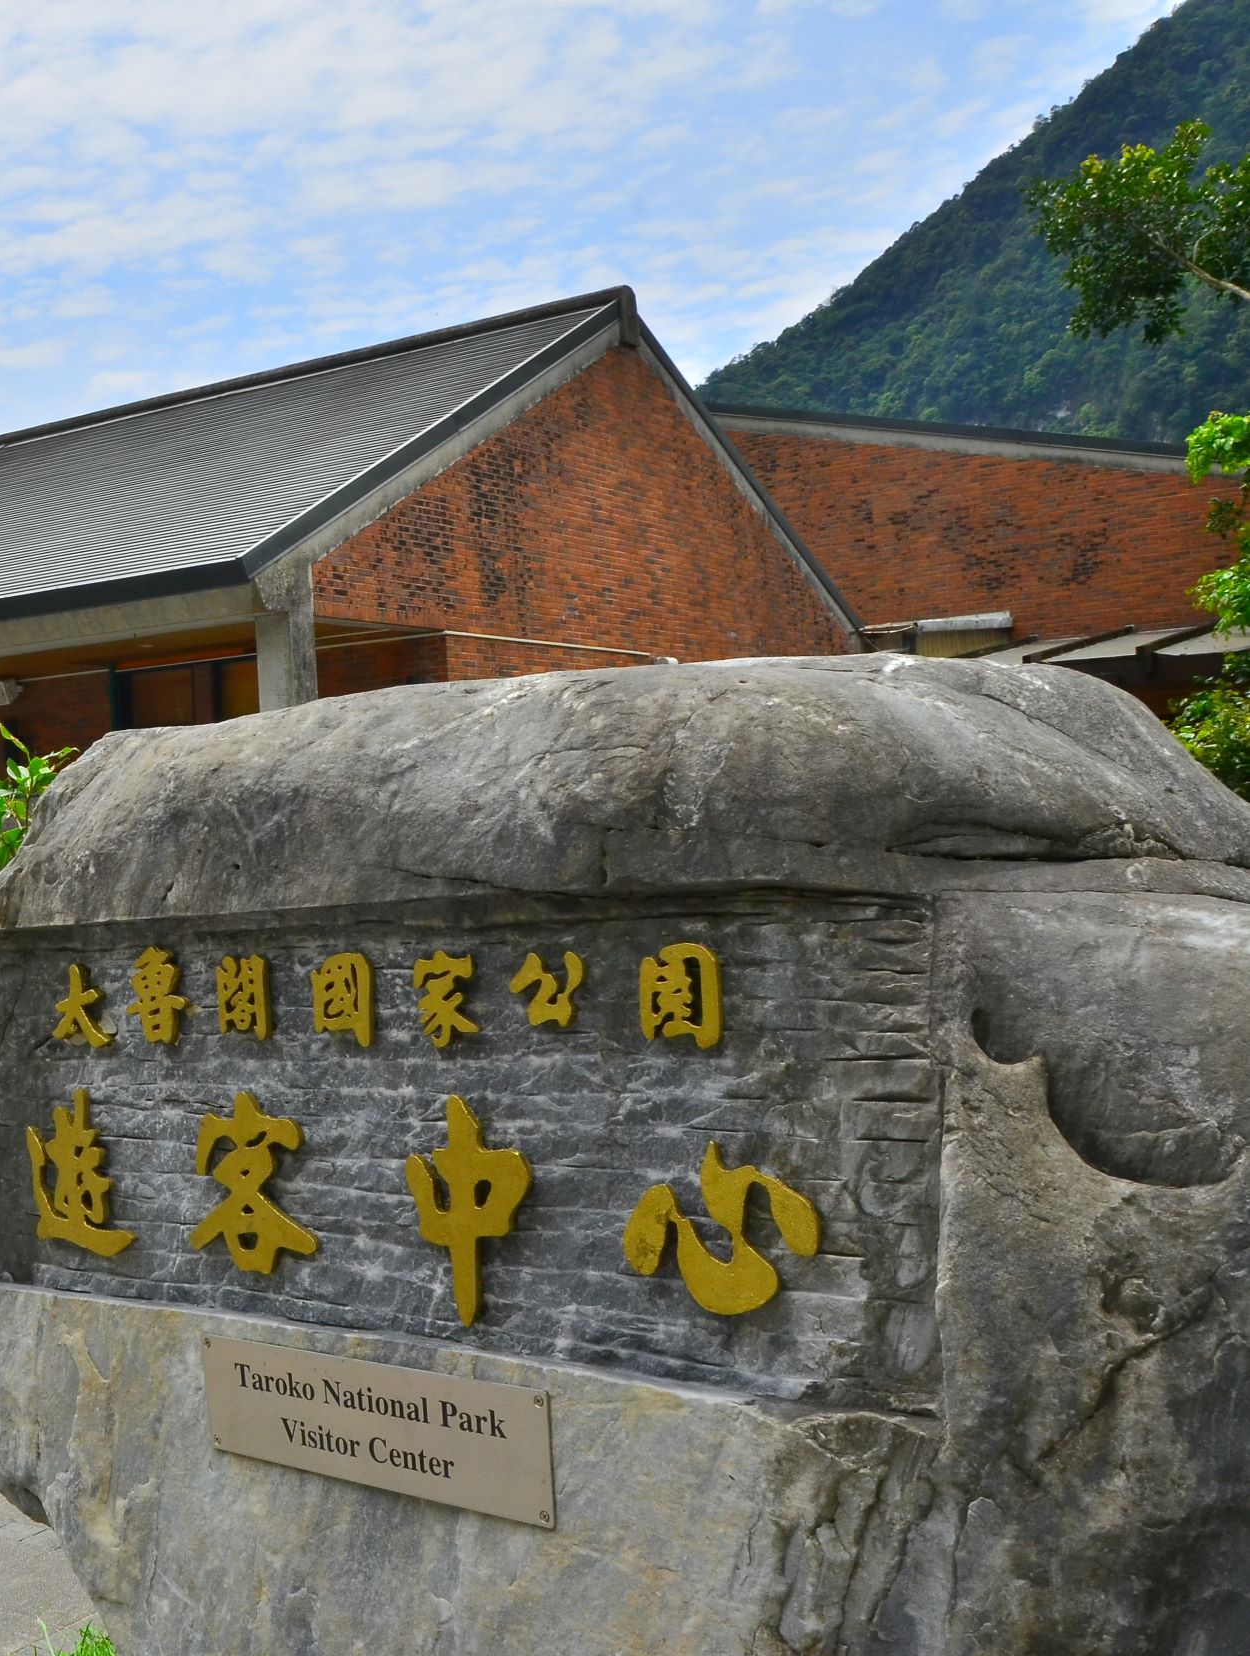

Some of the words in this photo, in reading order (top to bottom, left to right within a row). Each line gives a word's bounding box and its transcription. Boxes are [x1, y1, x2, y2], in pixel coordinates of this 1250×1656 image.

[52, 943, 725, 1049] 太魯閣國家公園
[25, 1089, 821, 1328] 遊客中心
[234, 1362, 315, 1401] Taroko
[322, 1378, 431, 1424] National
[439, 1400, 507, 1439] Park
[280, 1417, 360, 1458] Visitor
[368, 1436, 455, 1479] Center
